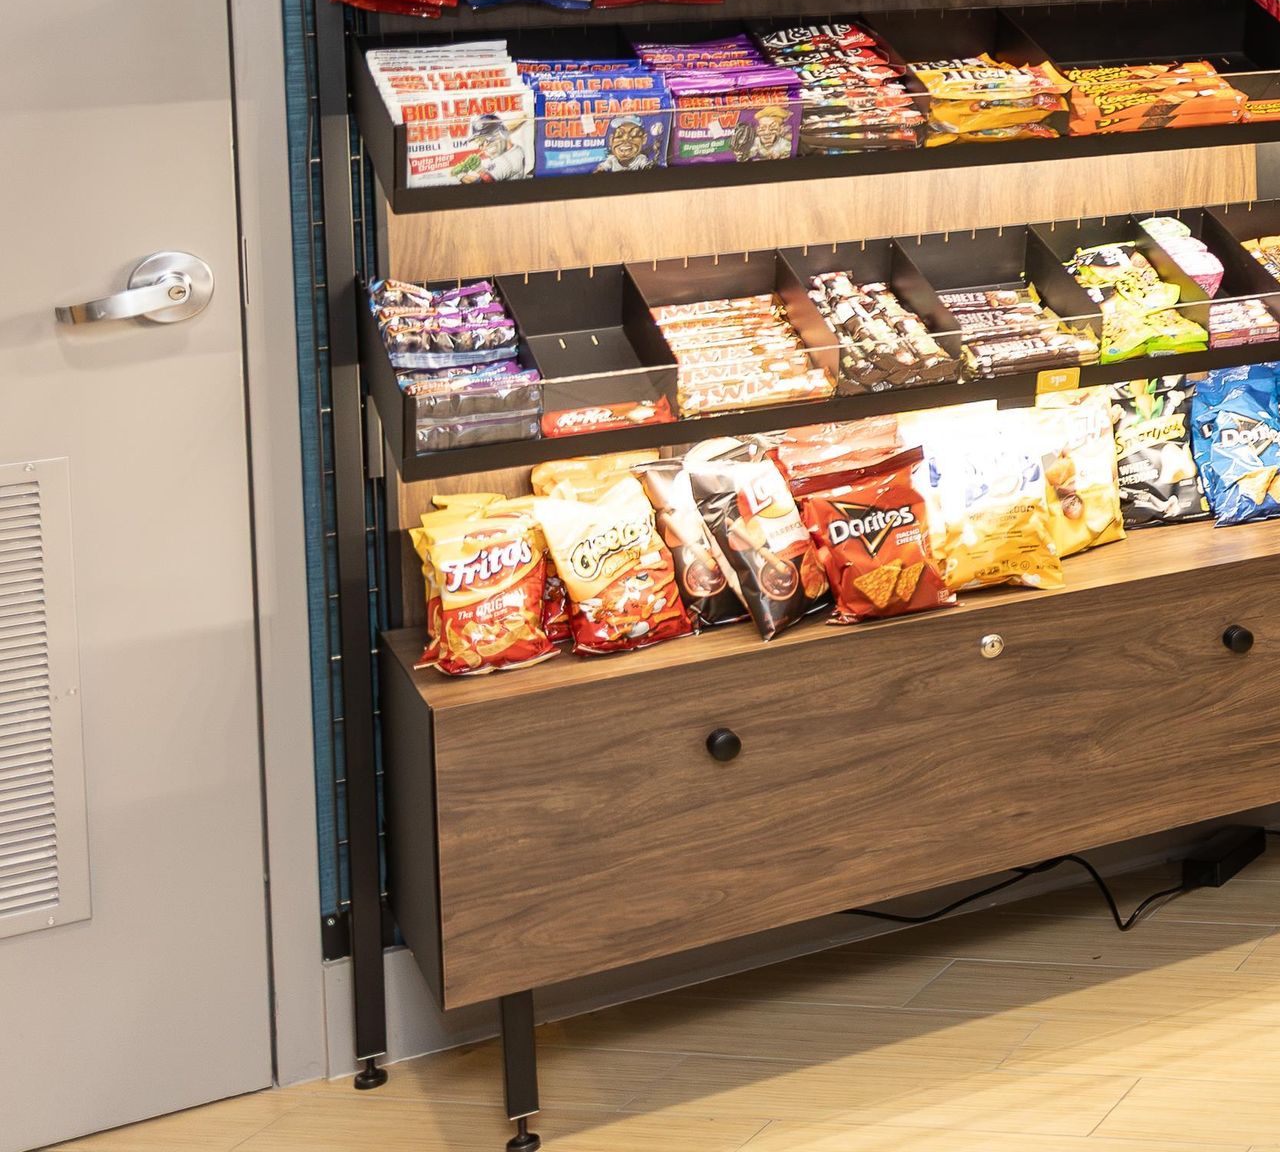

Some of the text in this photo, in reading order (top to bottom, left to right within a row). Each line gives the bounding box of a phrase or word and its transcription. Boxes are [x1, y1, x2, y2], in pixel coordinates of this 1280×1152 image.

[401, 94, 523, 123] BIG LEAGUE
[544, 97, 661, 119] BIG LEAGUE
[544, 139, 605, 148] BUBBLE GUM
[828, 505, 915, 545] Doritos
[896, 529, 920, 539] NACHO
[571, 519, 652, 579] Cheetos
[441, 538, 532, 592] Fritos
[457, 610, 474, 620] The
